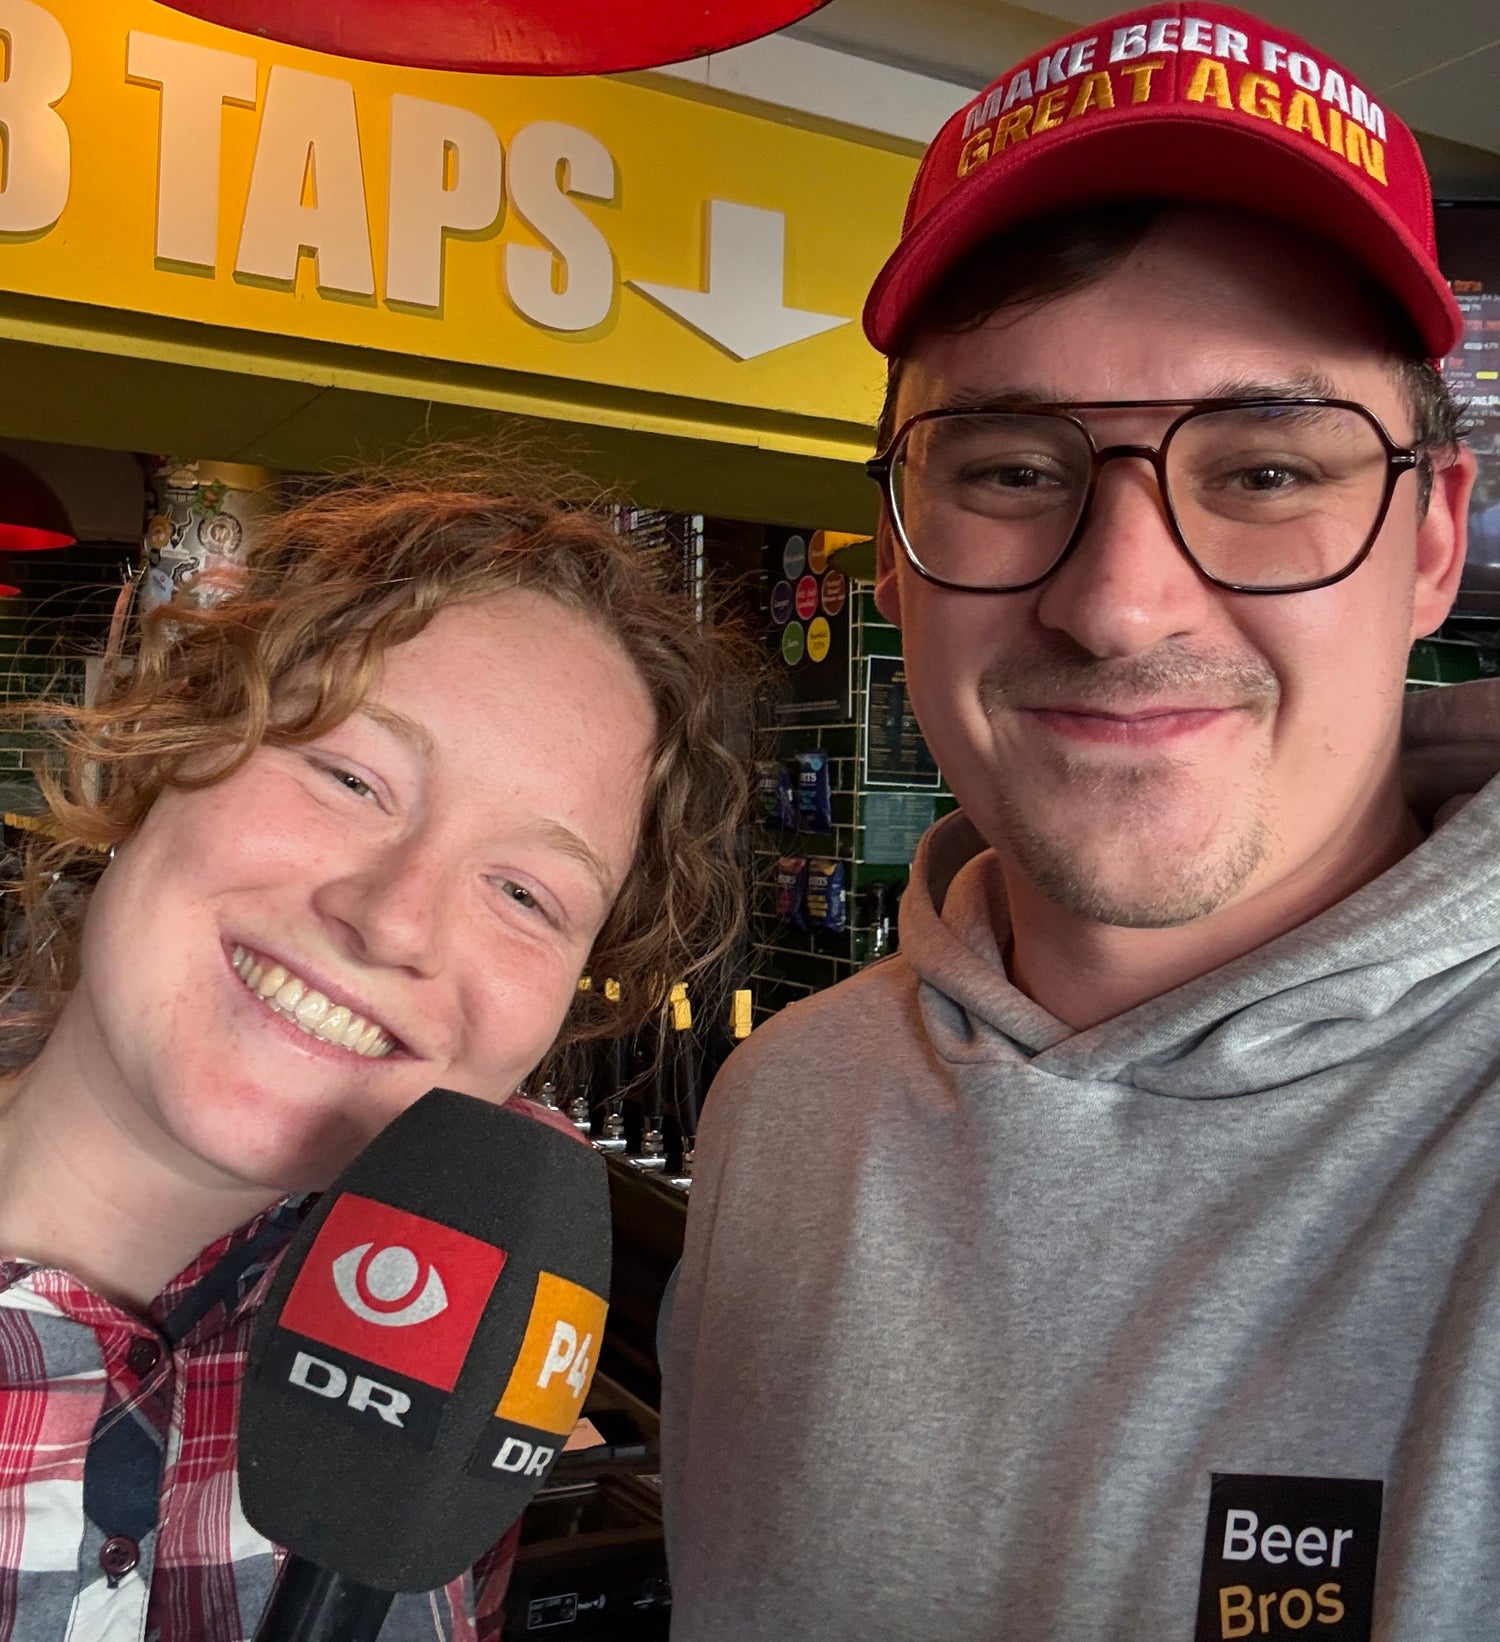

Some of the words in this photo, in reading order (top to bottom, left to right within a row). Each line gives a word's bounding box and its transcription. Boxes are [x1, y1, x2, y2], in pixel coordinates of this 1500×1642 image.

[962, 37, 1098, 141] MAKE
[1109, 17, 1250, 65] BEER
[1261, 39, 1389, 142] FOAM
[956, 61, 1164, 180] GREAT
[1186, 58, 1389, 187] AGAIN
[126, 30, 615, 333] TAPS
[288, 1351, 412, 1428] DR
[536, 1320, 594, 1399] P4
[491, 1436, 556, 1477] DR
[1222, 1508, 1353, 1569] Beer
[1219, 1582, 1345, 1640] Bros
